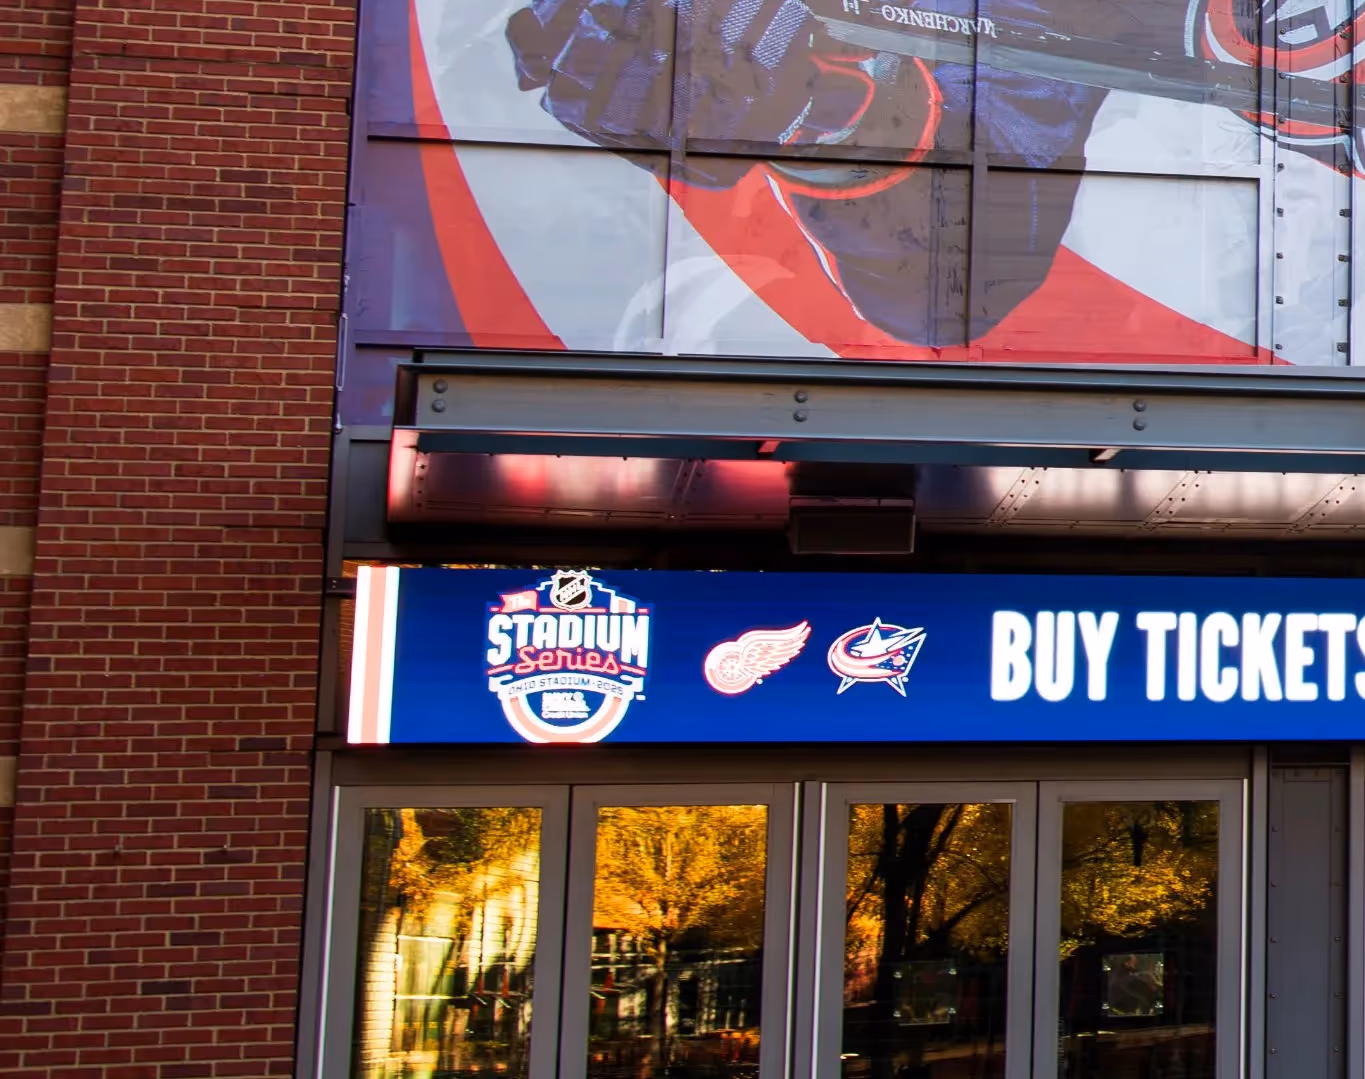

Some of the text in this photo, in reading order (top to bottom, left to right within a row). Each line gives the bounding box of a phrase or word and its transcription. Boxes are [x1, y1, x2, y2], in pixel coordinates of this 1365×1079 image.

[881, 4, 998, 38] MARCHENKO
[486, 614, 650, 667] STADIUM
[990, 610, 1121, 702] BUY
[514, 645, 622, 674] Series
[539, 676, 591, 688] STADIUM
